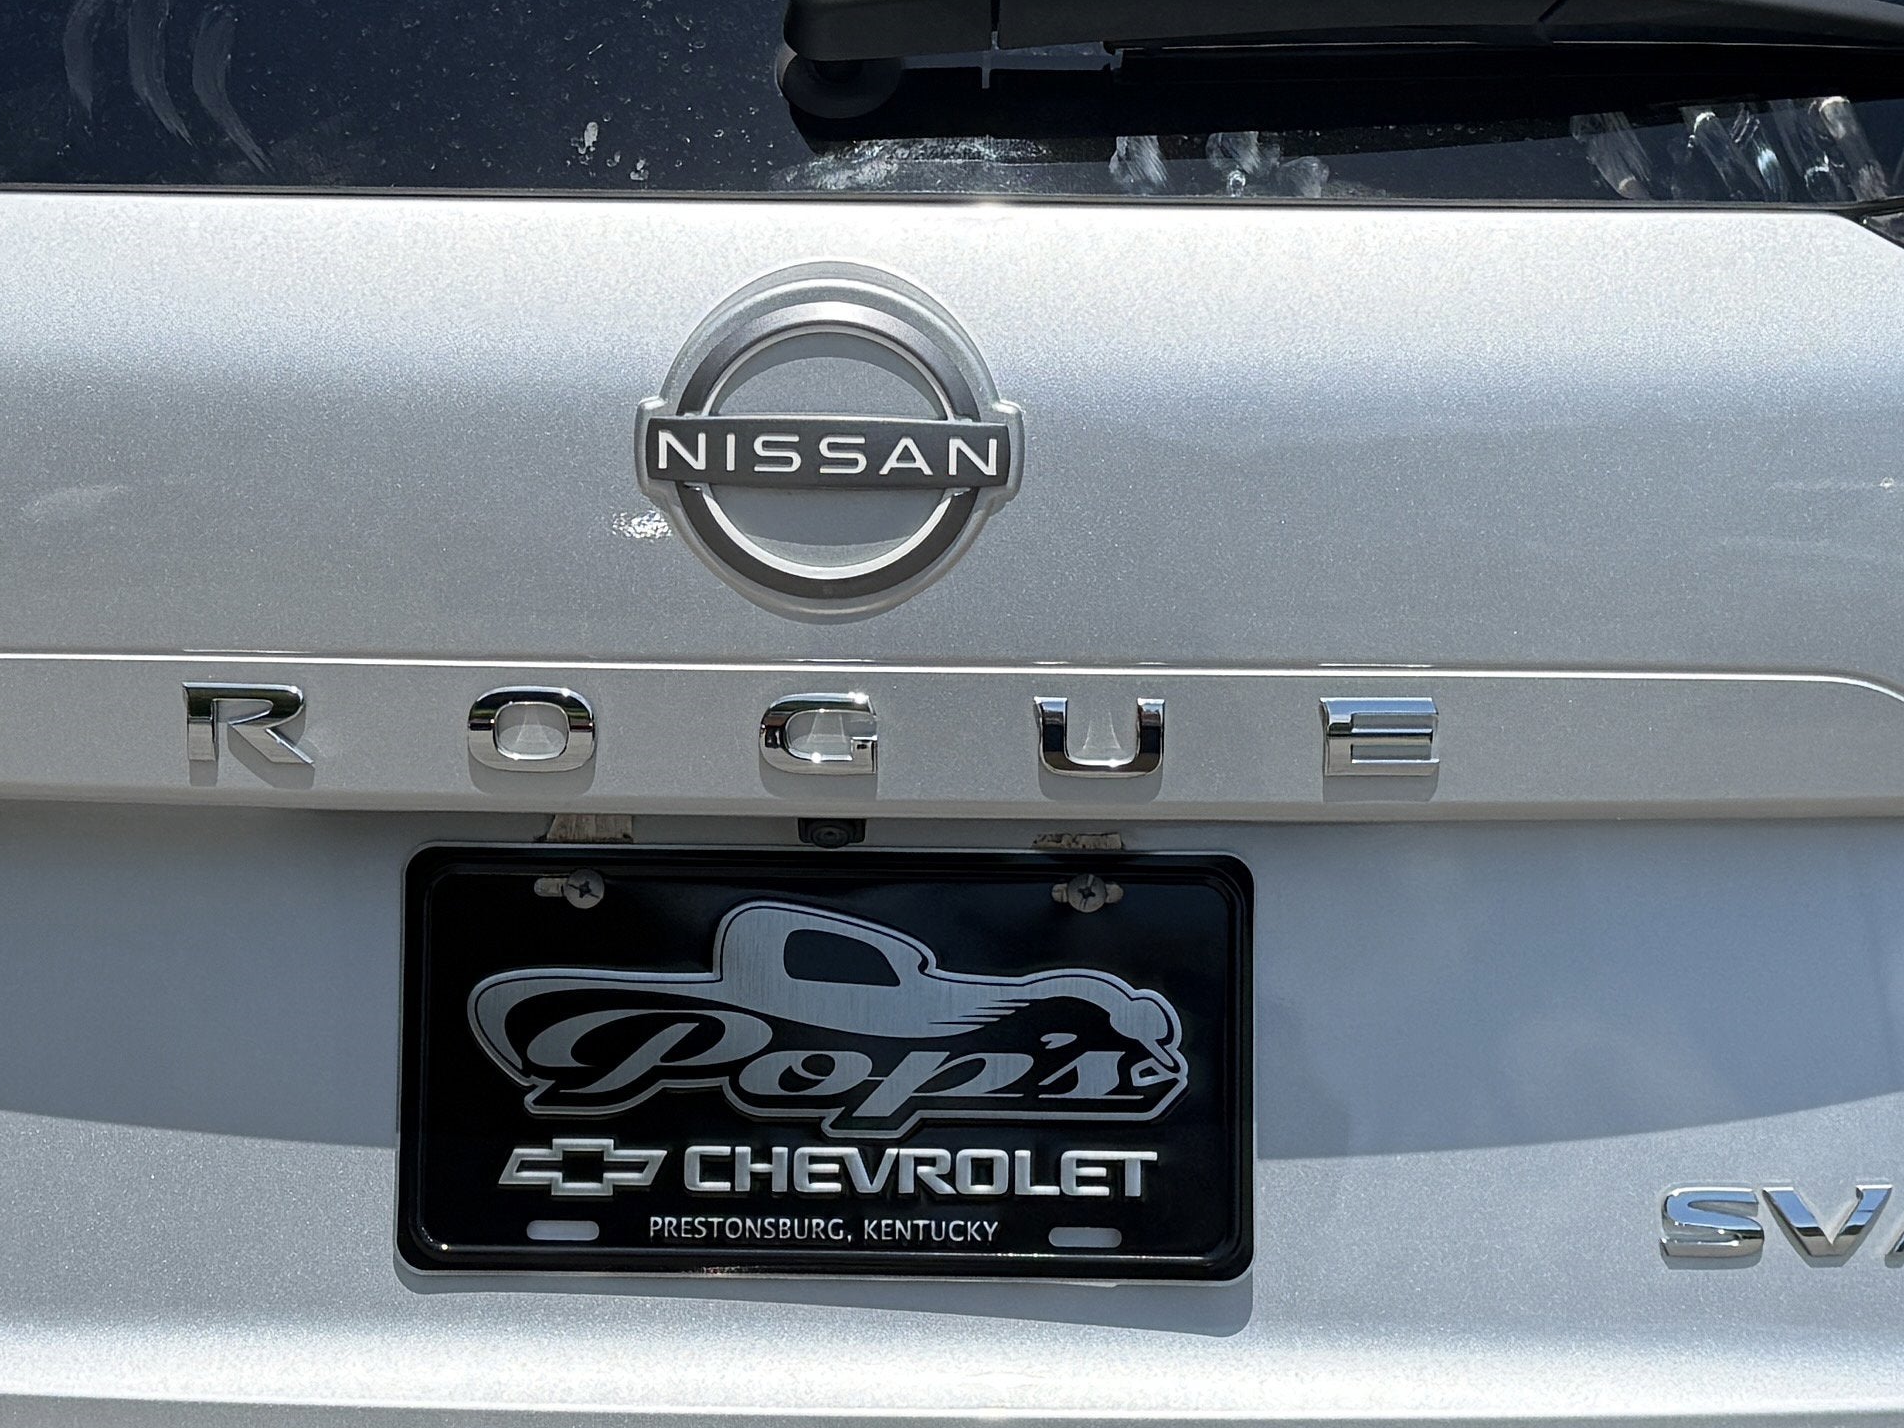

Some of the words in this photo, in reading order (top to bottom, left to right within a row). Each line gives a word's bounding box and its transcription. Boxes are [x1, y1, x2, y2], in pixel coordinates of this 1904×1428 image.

[656, 429, 999, 477] NISSAN
[181, 679, 1442, 778] ROGUE
[683, 1143, 1159, 1200] CHEVROLET
[649, 1215, 853, 1244] PRESTONSBURG,
[863, 1219, 999, 1243] KENTUCKY
[1660, 1184, 1893, 1260] SV
